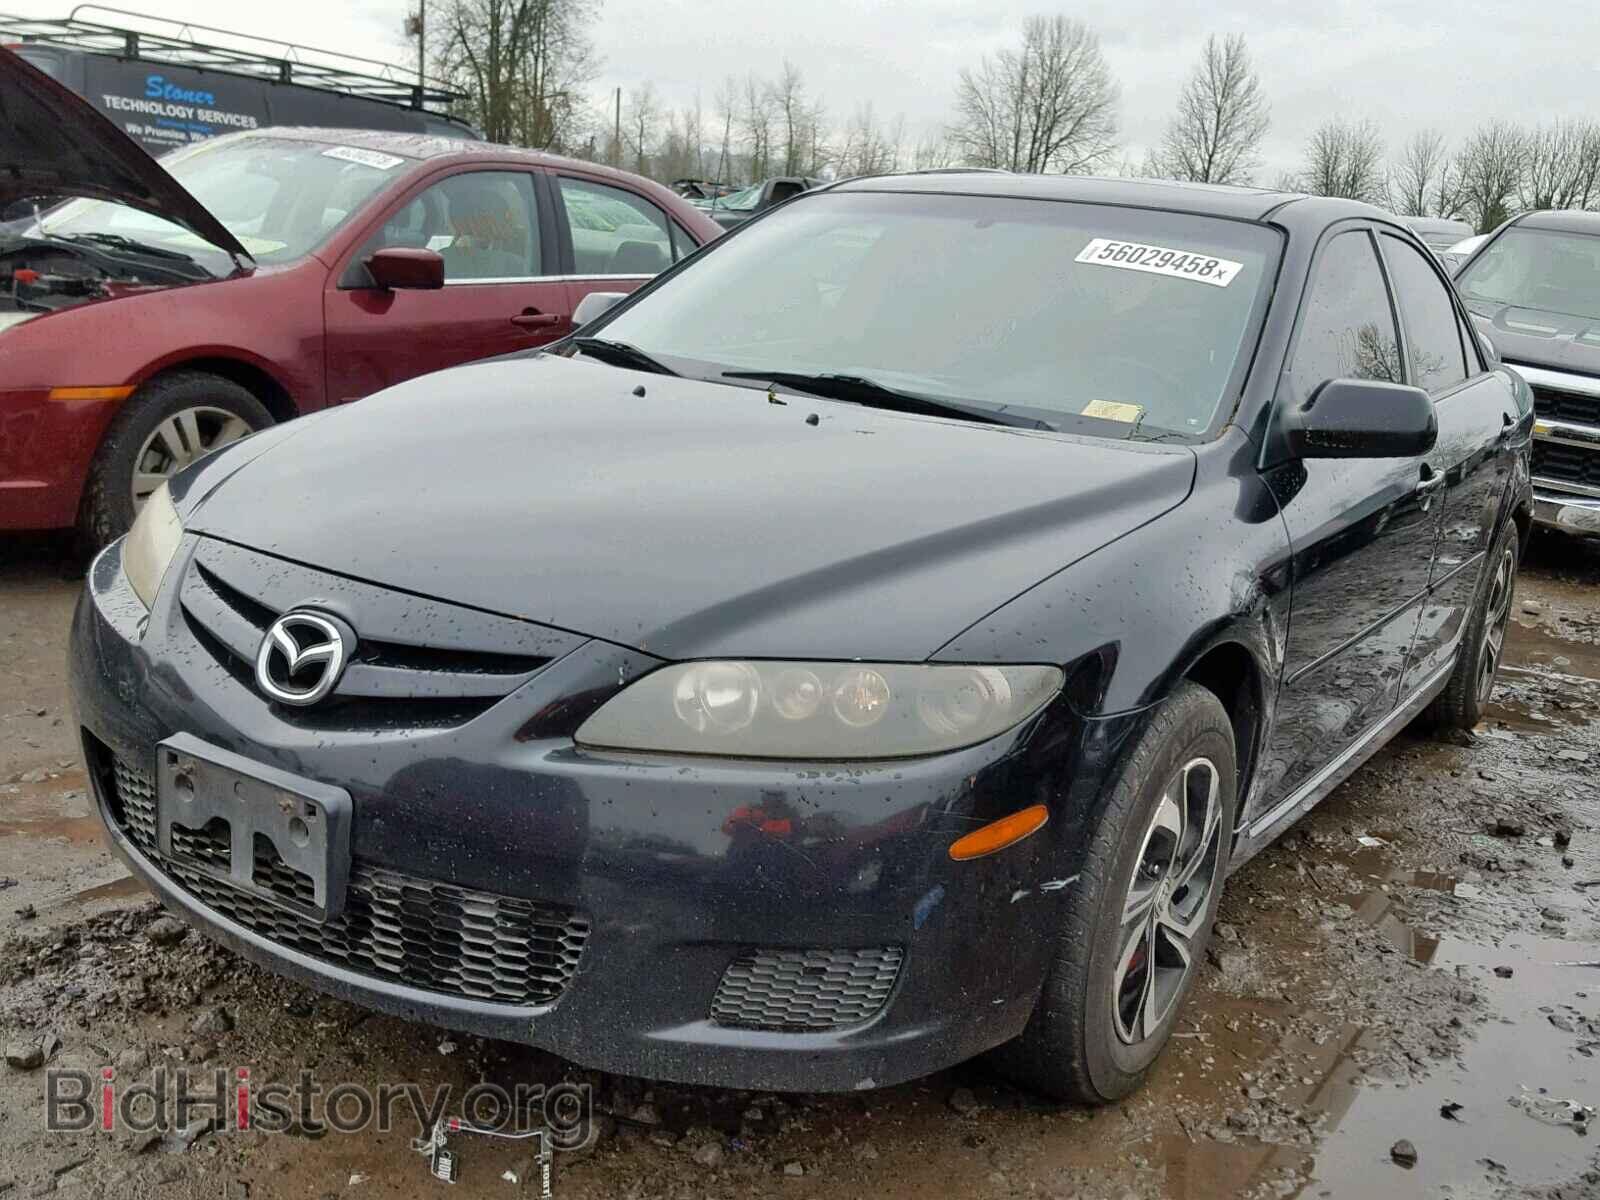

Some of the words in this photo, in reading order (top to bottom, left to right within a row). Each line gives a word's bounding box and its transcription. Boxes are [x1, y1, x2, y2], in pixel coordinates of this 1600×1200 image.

[102, 94, 194, 119] TECHNOLOGY
[197, 108, 258, 129] SERVICES
[125, 122, 143, 135] We
